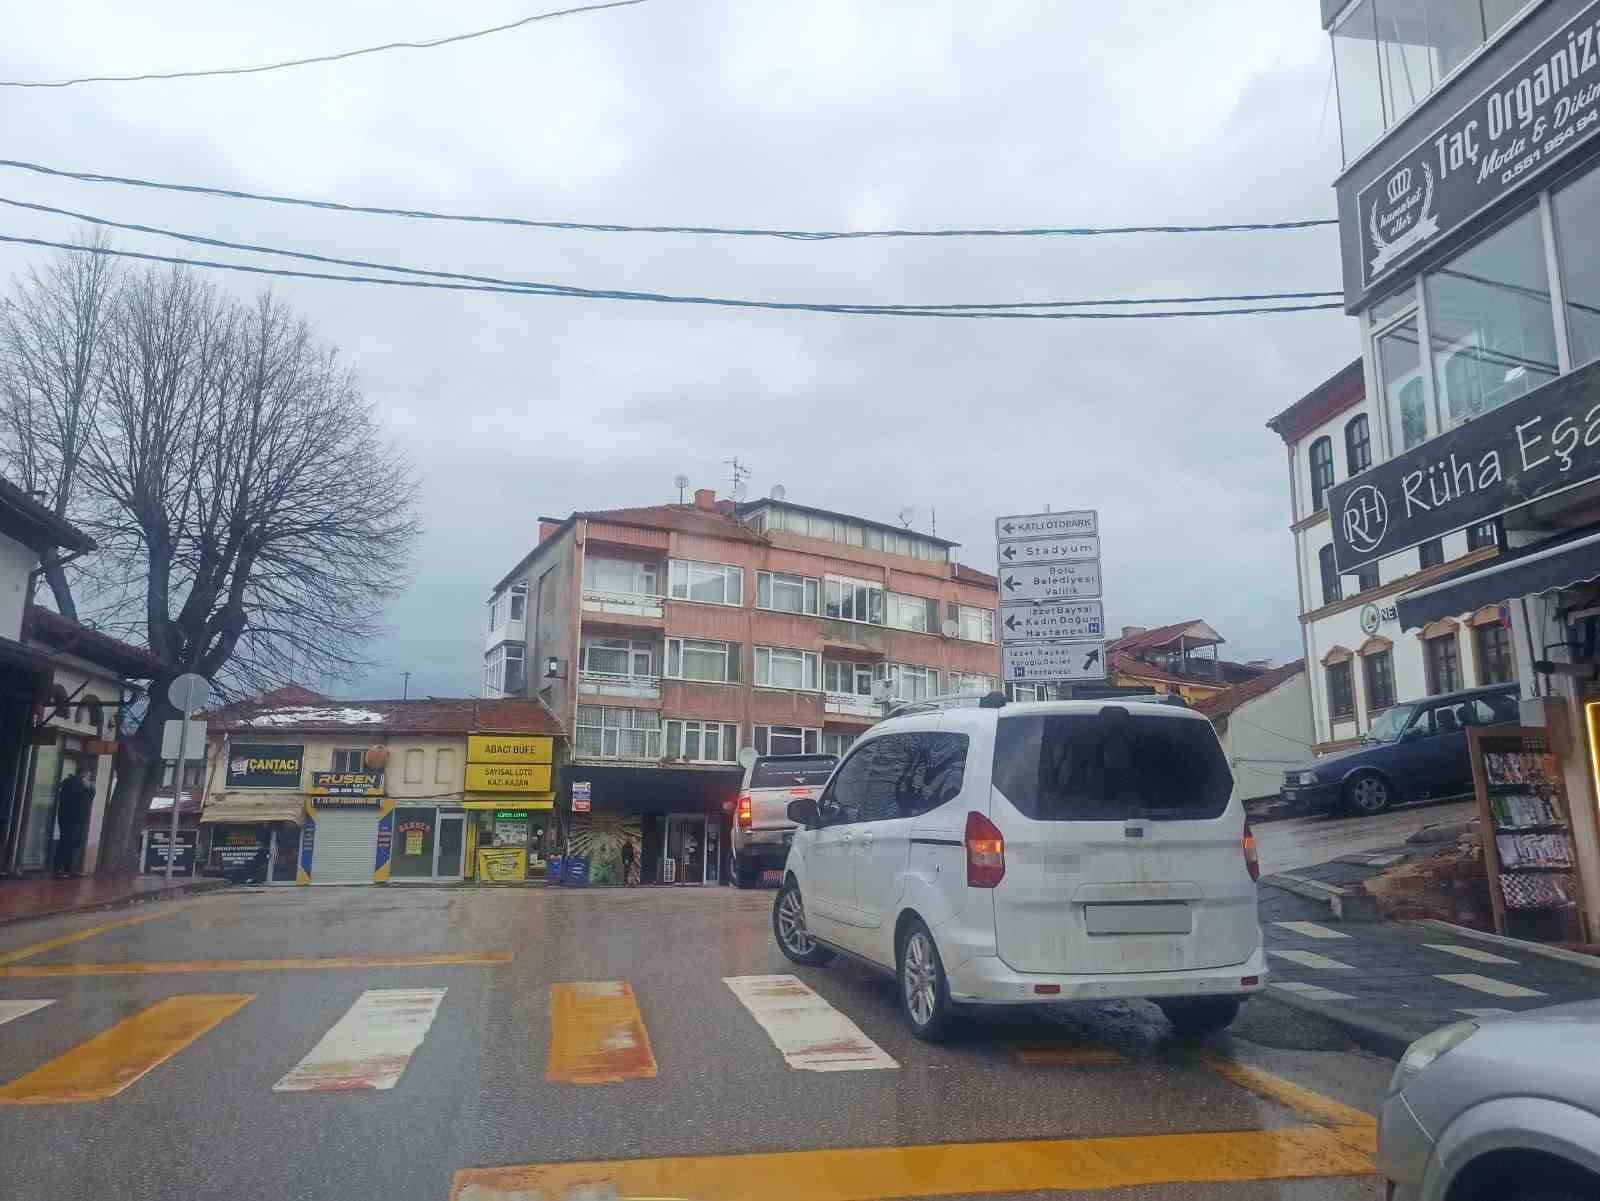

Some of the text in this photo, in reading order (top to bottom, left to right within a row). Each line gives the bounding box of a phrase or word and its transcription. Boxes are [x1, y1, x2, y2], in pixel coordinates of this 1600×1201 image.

[1435, 120, 1479, 180] Taç
[1476, 137, 1526, 185] Moda
[1532, 115, 1548, 144] &
[1401, 449, 1503, 519] Rüha
[1018, 518, 1092, 531] KATLI OTOPARK
[1026, 544, 1093, 556] Stadyum
[1049, 566, 1075, 575] Bolu
[1033, 575, 1095, 585] Belediyesi
[1057, 604, 1092, 615] Baysal
[1059, 614, 1100, 624] Doğum
[1026, 628, 1088, 638] Hastanesi
